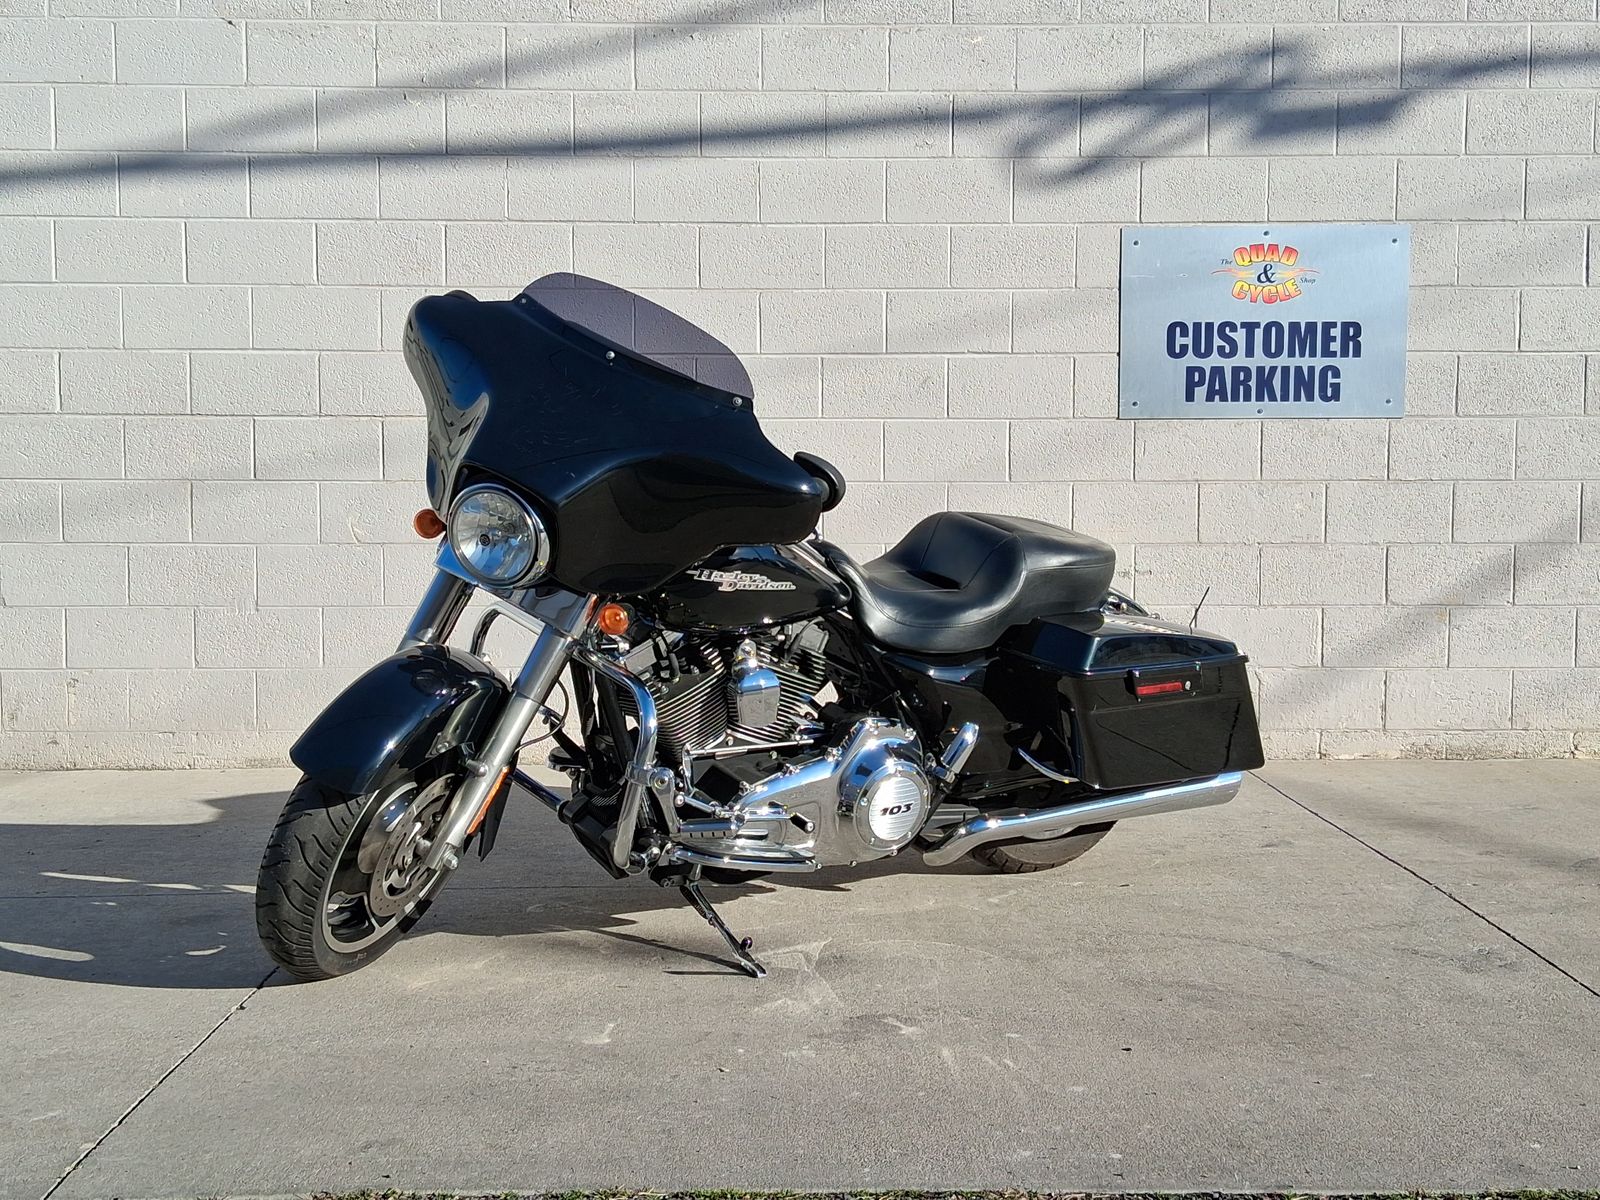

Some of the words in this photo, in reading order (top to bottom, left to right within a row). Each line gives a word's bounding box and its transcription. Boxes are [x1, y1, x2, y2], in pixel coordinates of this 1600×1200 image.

[1233, 243, 1299, 267] QUAD
[1256, 263, 1277, 284] &
[1299, 277, 1317, 285] Shop
[1232, 278, 1302, 304] CYCLE
[1166, 321, 1362, 359] CUSTOMER
[1185, 365, 1341, 403] PARKING
[717, 579, 797, 592] Davidson
[880, 803, 914, 816] 103
